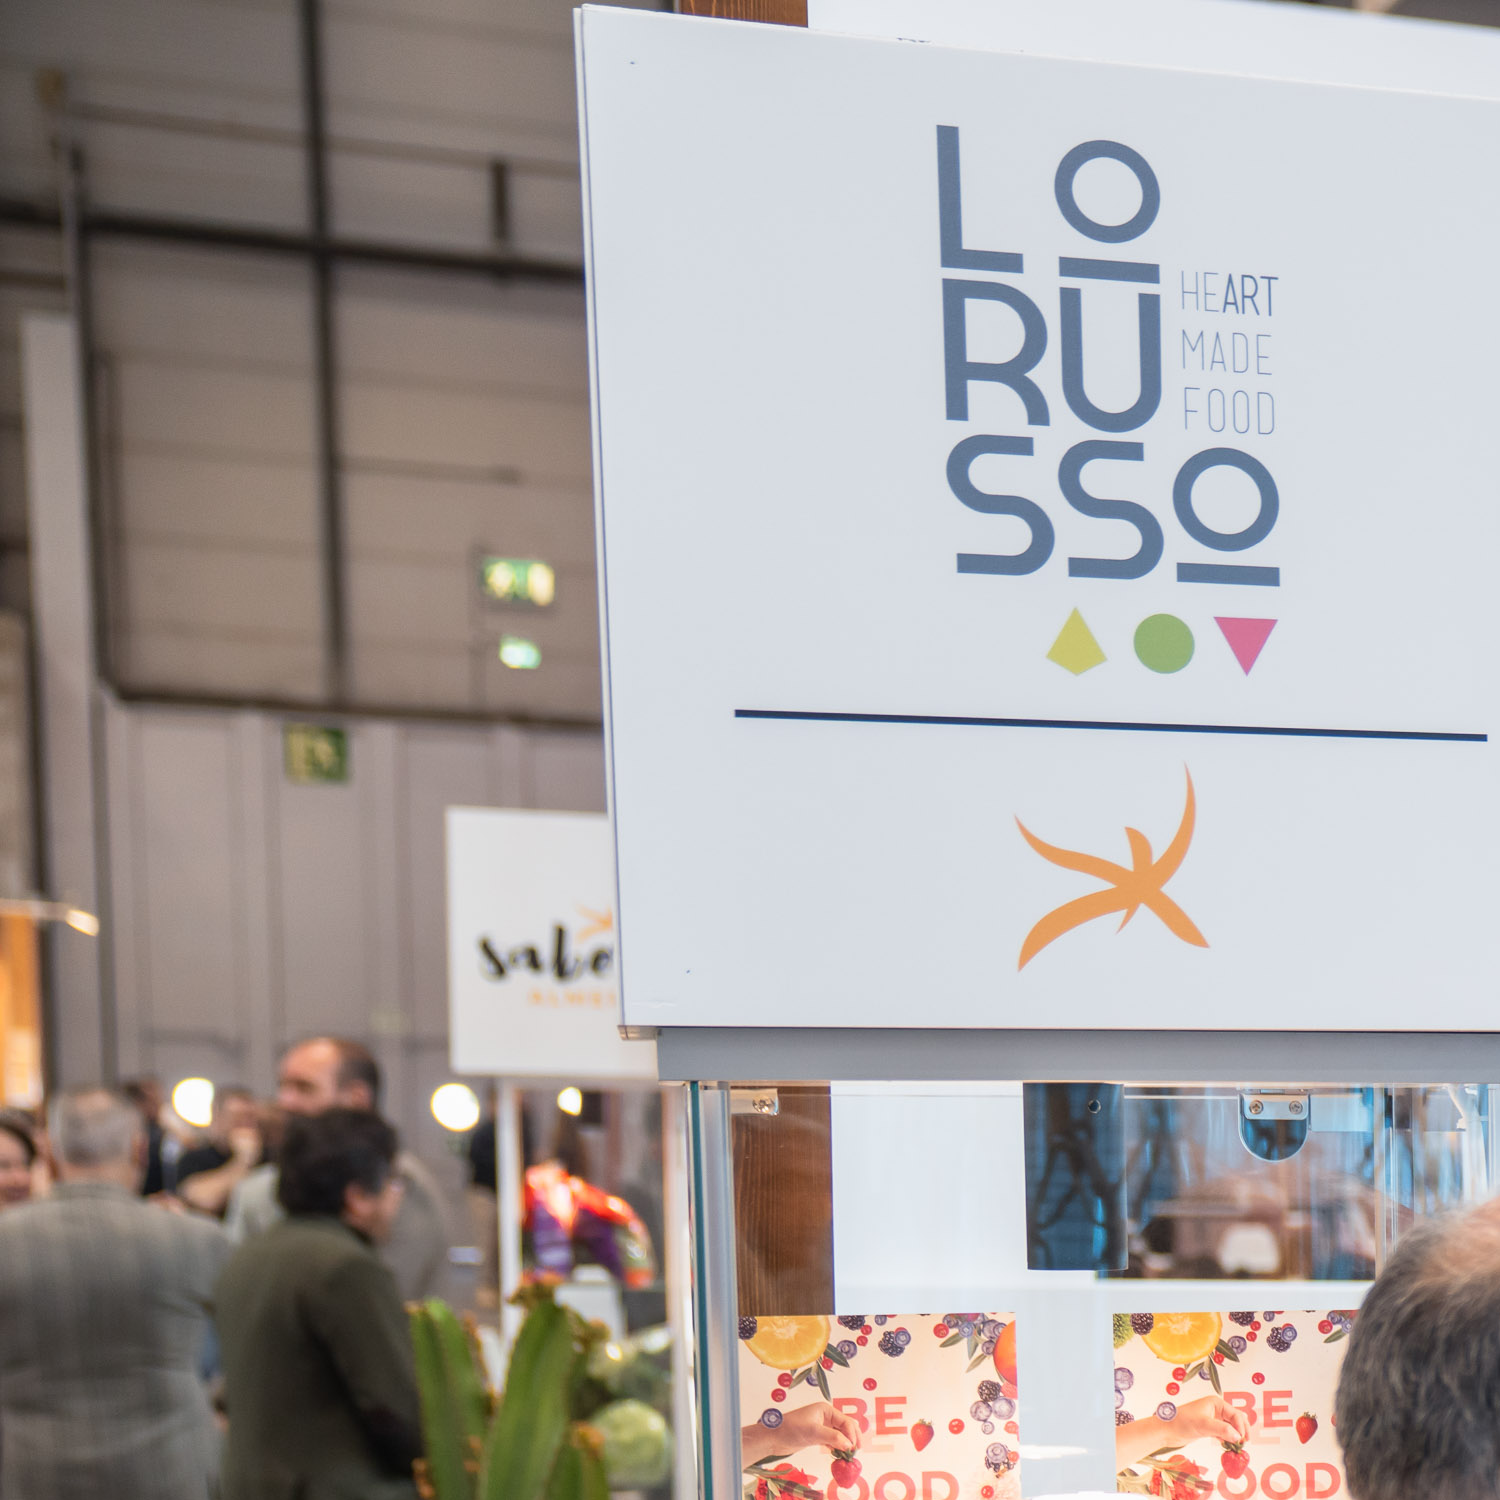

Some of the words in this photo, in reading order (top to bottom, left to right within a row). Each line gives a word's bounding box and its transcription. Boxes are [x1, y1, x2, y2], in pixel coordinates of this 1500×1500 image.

[1181, 270, 1280, 317] HEART
[1181, 329, 1273, 376] MADE
[1183, 387, 1276, 436] FOOD
[478, 922, 614, 982] sabo
